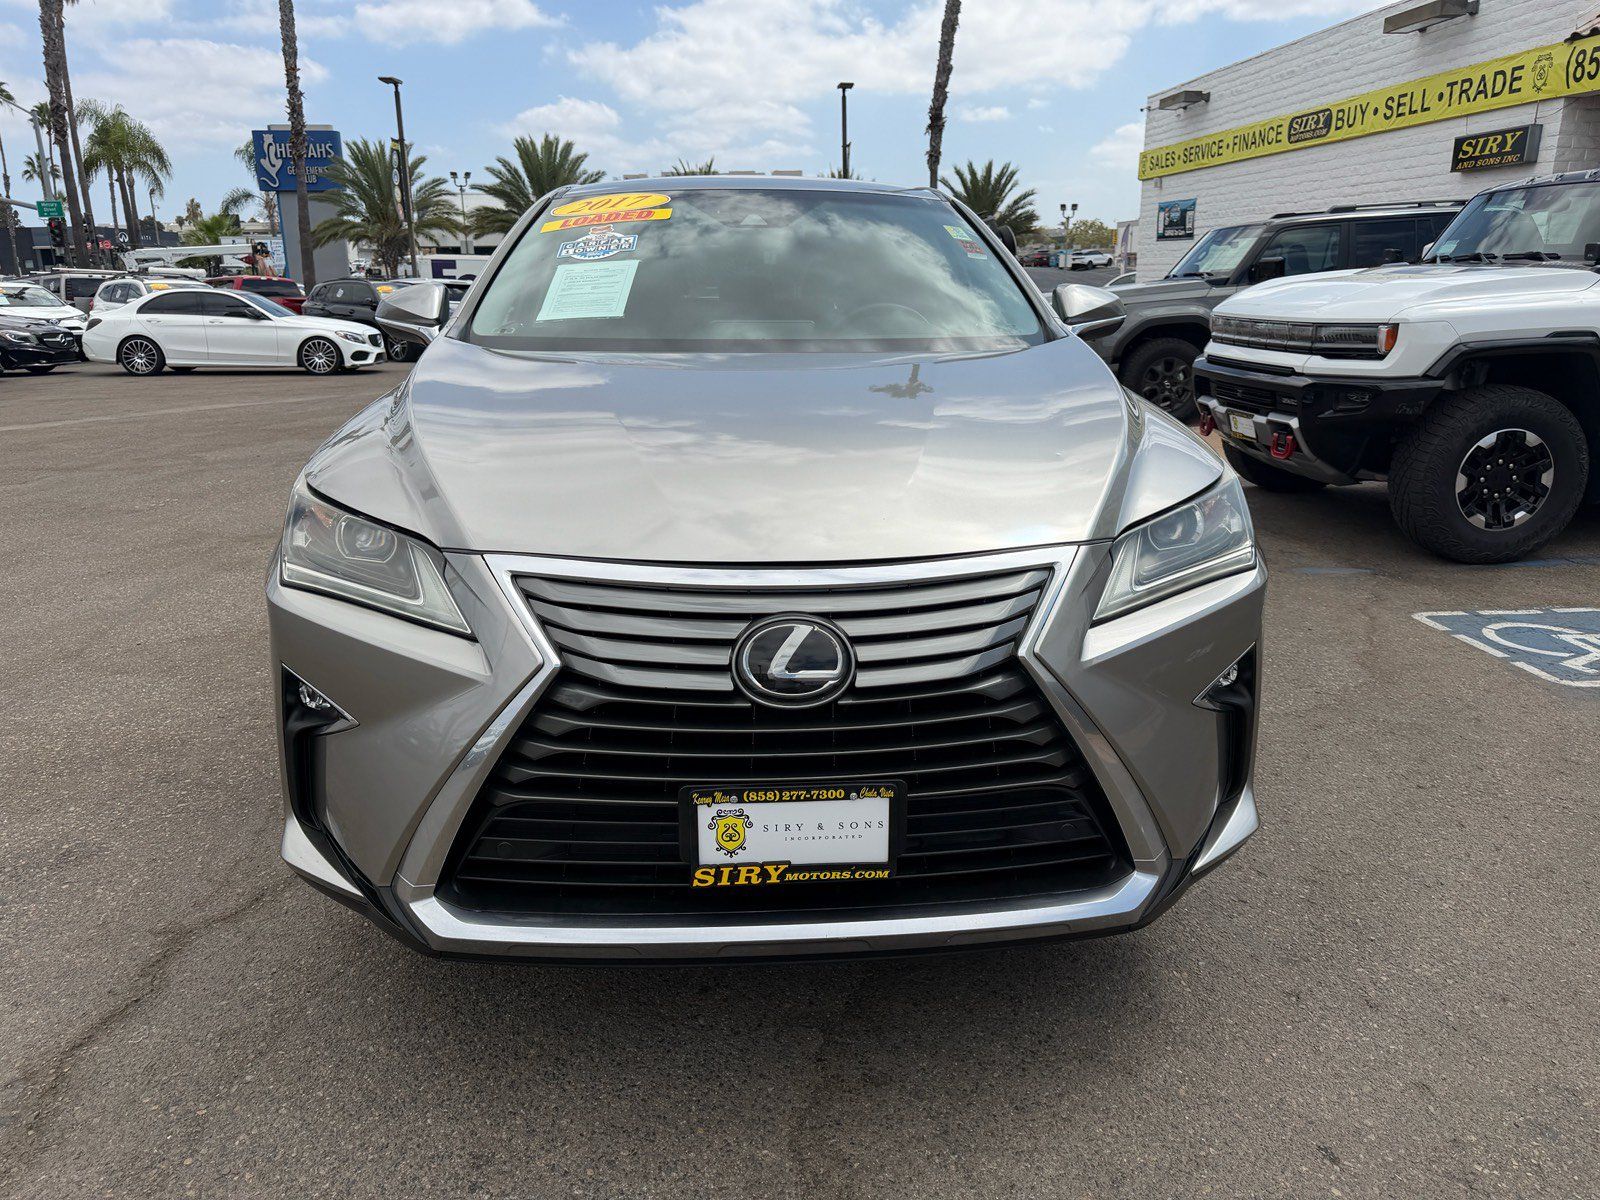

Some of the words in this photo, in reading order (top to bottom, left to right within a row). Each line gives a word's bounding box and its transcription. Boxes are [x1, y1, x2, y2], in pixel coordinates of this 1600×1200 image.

[1334, 102, 1371, 131] BUY
[1383, 88, 1431, 121] SELL
[1446, 64, 1526, 107] TRADE
[1290, 111, 1330, 134] SIRY
[1149, 152, 1176, 172] SALES
[1182, 139, 1224, 164] SERVICE
[1232, 123, 1283, 153] FINANCE
[1458, 131, 1524, 159] SIRY
[1456, 161, 1475, 170] AND
[1476, 157, 1501, 167] SONS
[1502, 153, 1521, 163] INC
[567, 195, 653, 215] 2017
[560, 210, 655, 228] LOADED
[762, 822, 805, 833] SIRY
[816, 822, 826, 831] &
[838, 820, 886, 831] SONS
[784, 834, 864, 842] INCORPORATED
